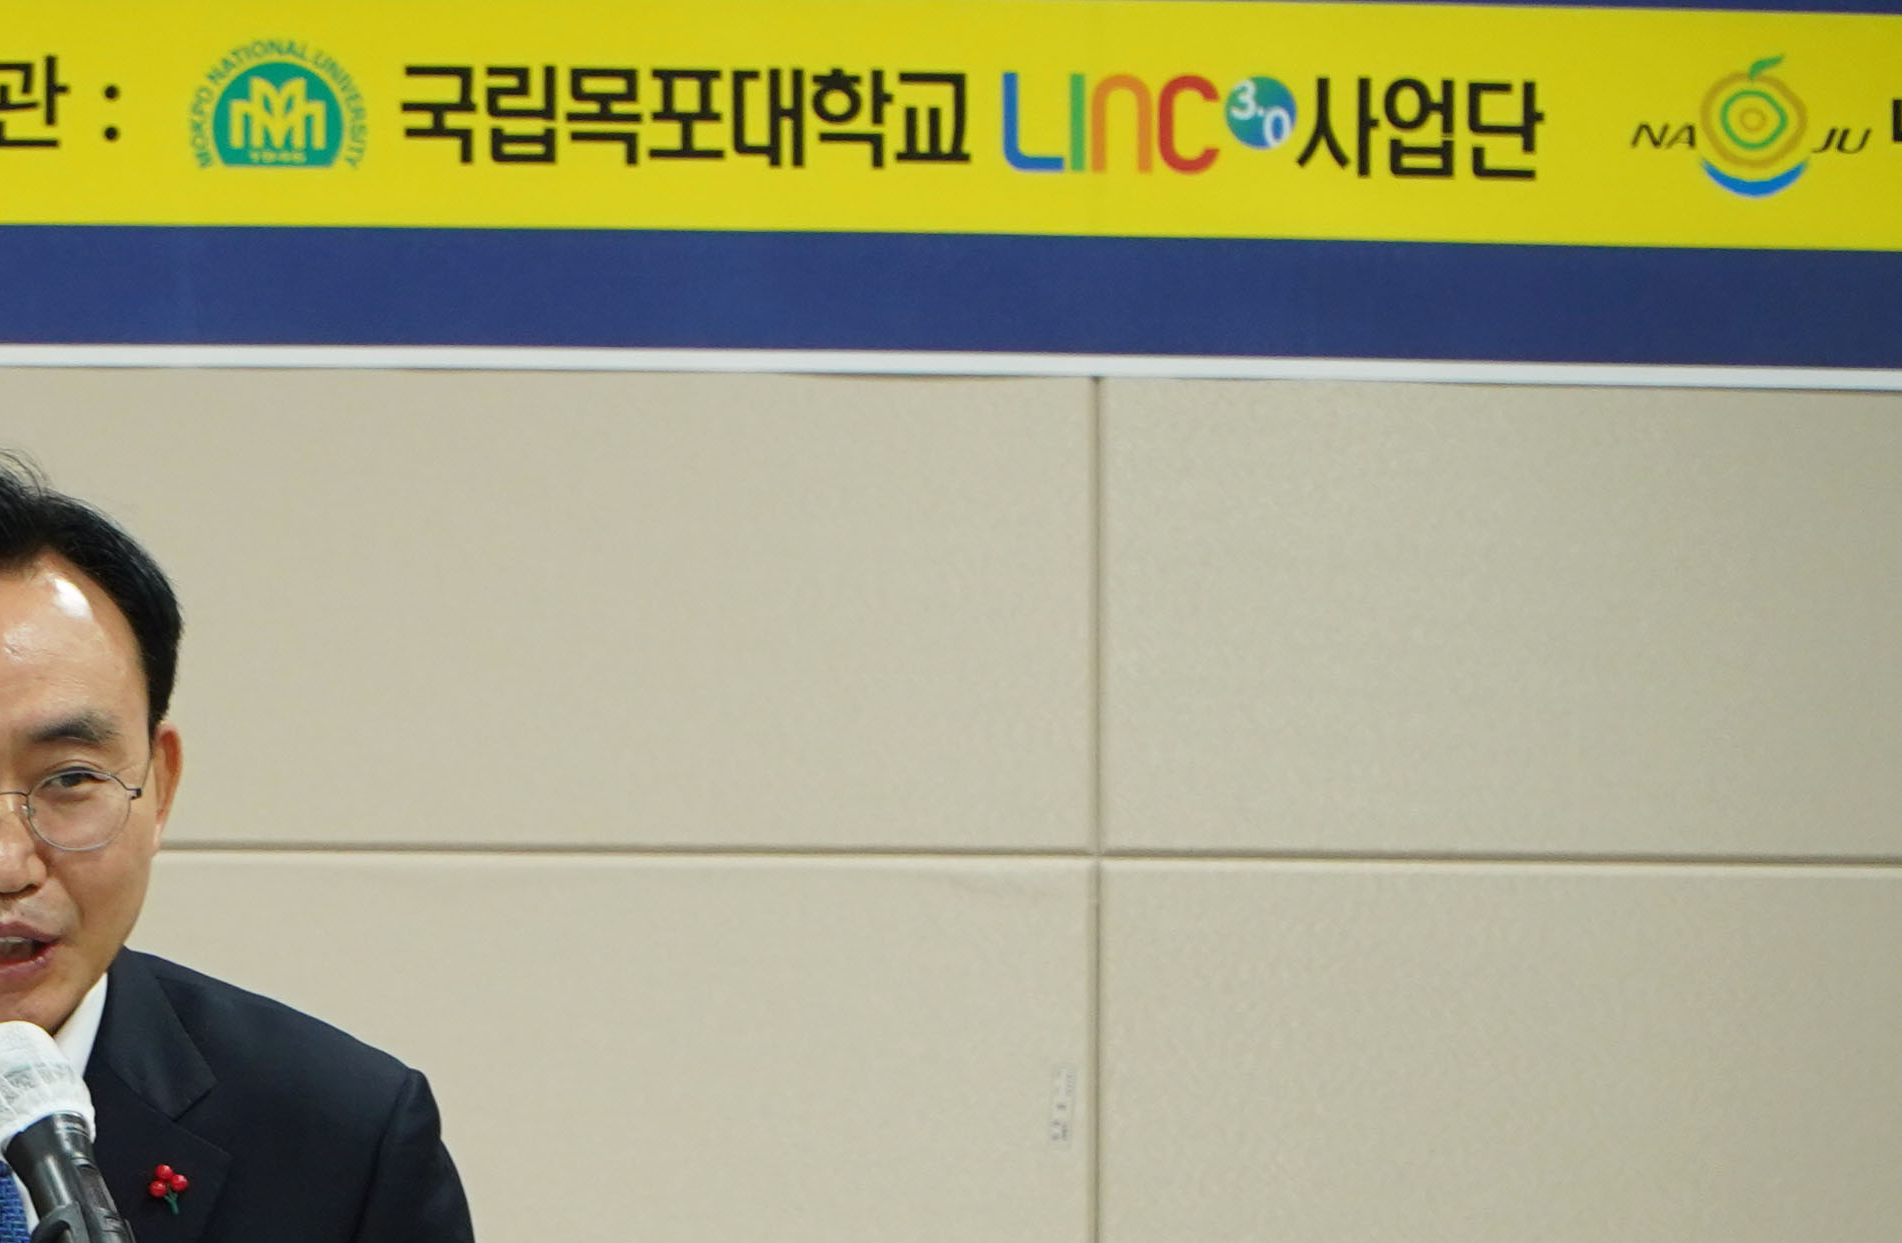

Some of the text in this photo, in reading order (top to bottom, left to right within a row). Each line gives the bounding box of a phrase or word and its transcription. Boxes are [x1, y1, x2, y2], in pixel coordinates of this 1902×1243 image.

[207, 39, 308, 84] NATIONAL
[312, 49, 368, 171] UNIVERSITY
[401, 65, 971, 169] 국립목포대학교
[1295, 77, 1545, 181] 사업단
[1630, 122, 1872, 155] NA JU
